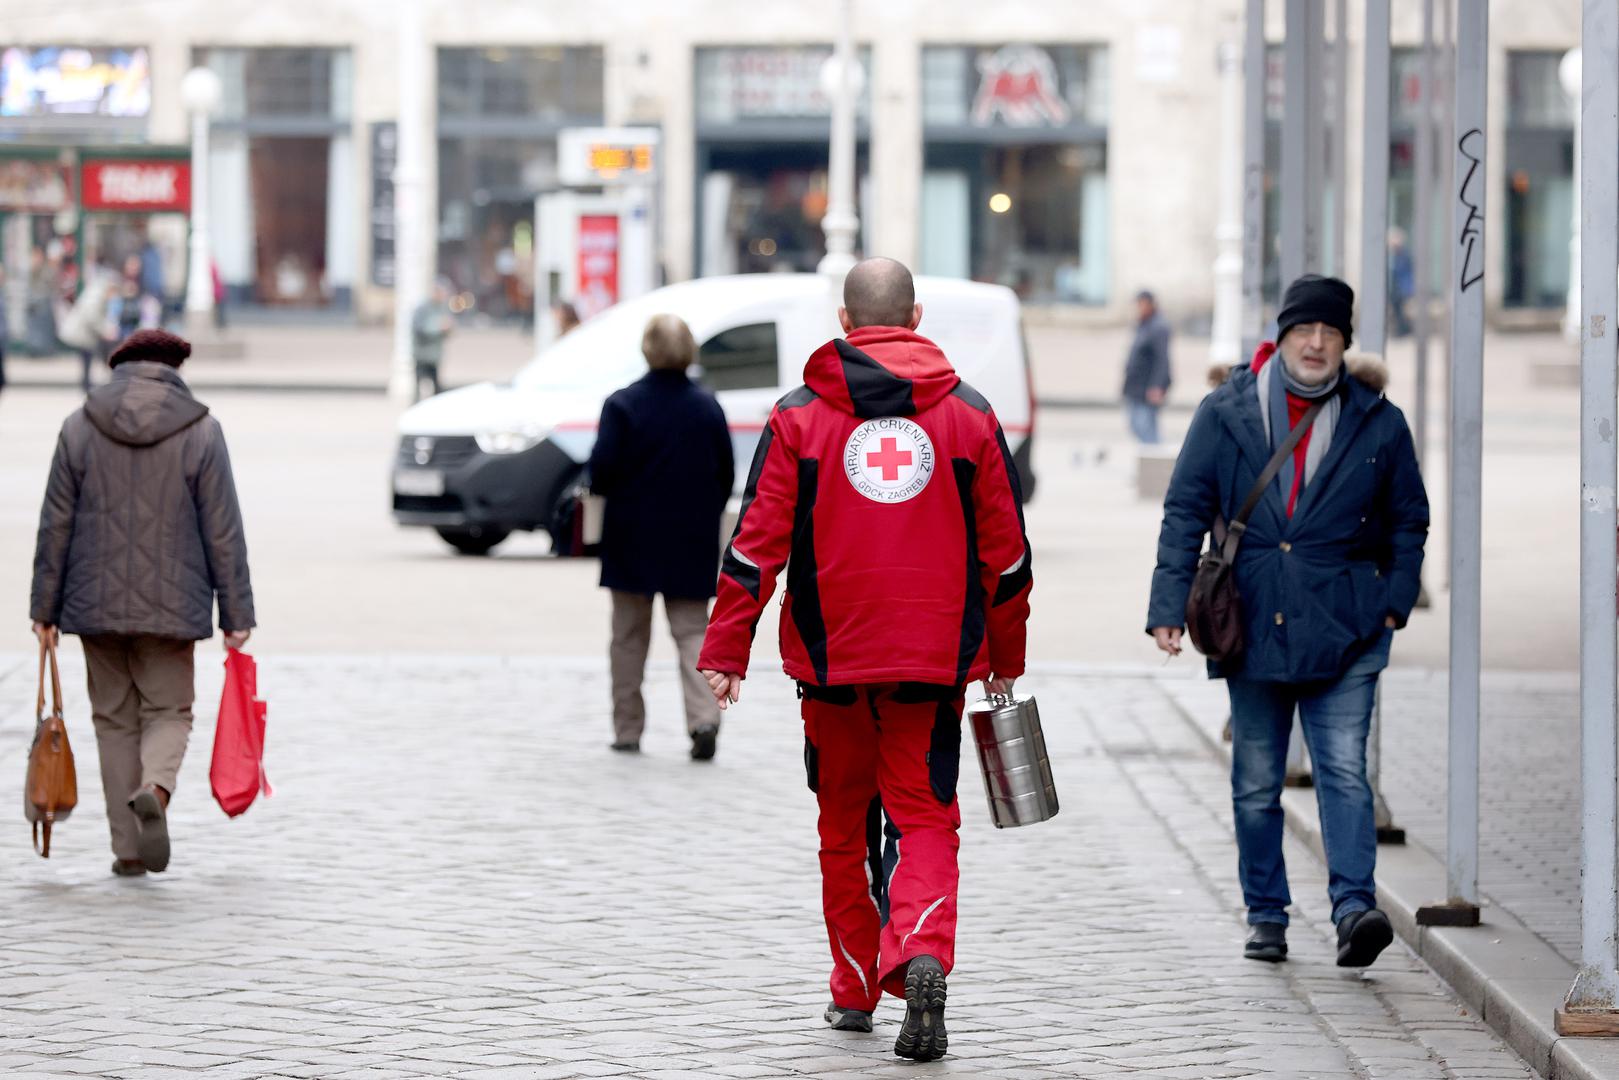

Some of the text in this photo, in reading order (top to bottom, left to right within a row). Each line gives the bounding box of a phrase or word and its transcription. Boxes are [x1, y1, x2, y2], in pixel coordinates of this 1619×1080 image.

[848, 423, 876, 476] HRVATSKI
[879, 419, 924, 442] CRVENI
[858, 478, 924, 500] GDCK ZAGREB
